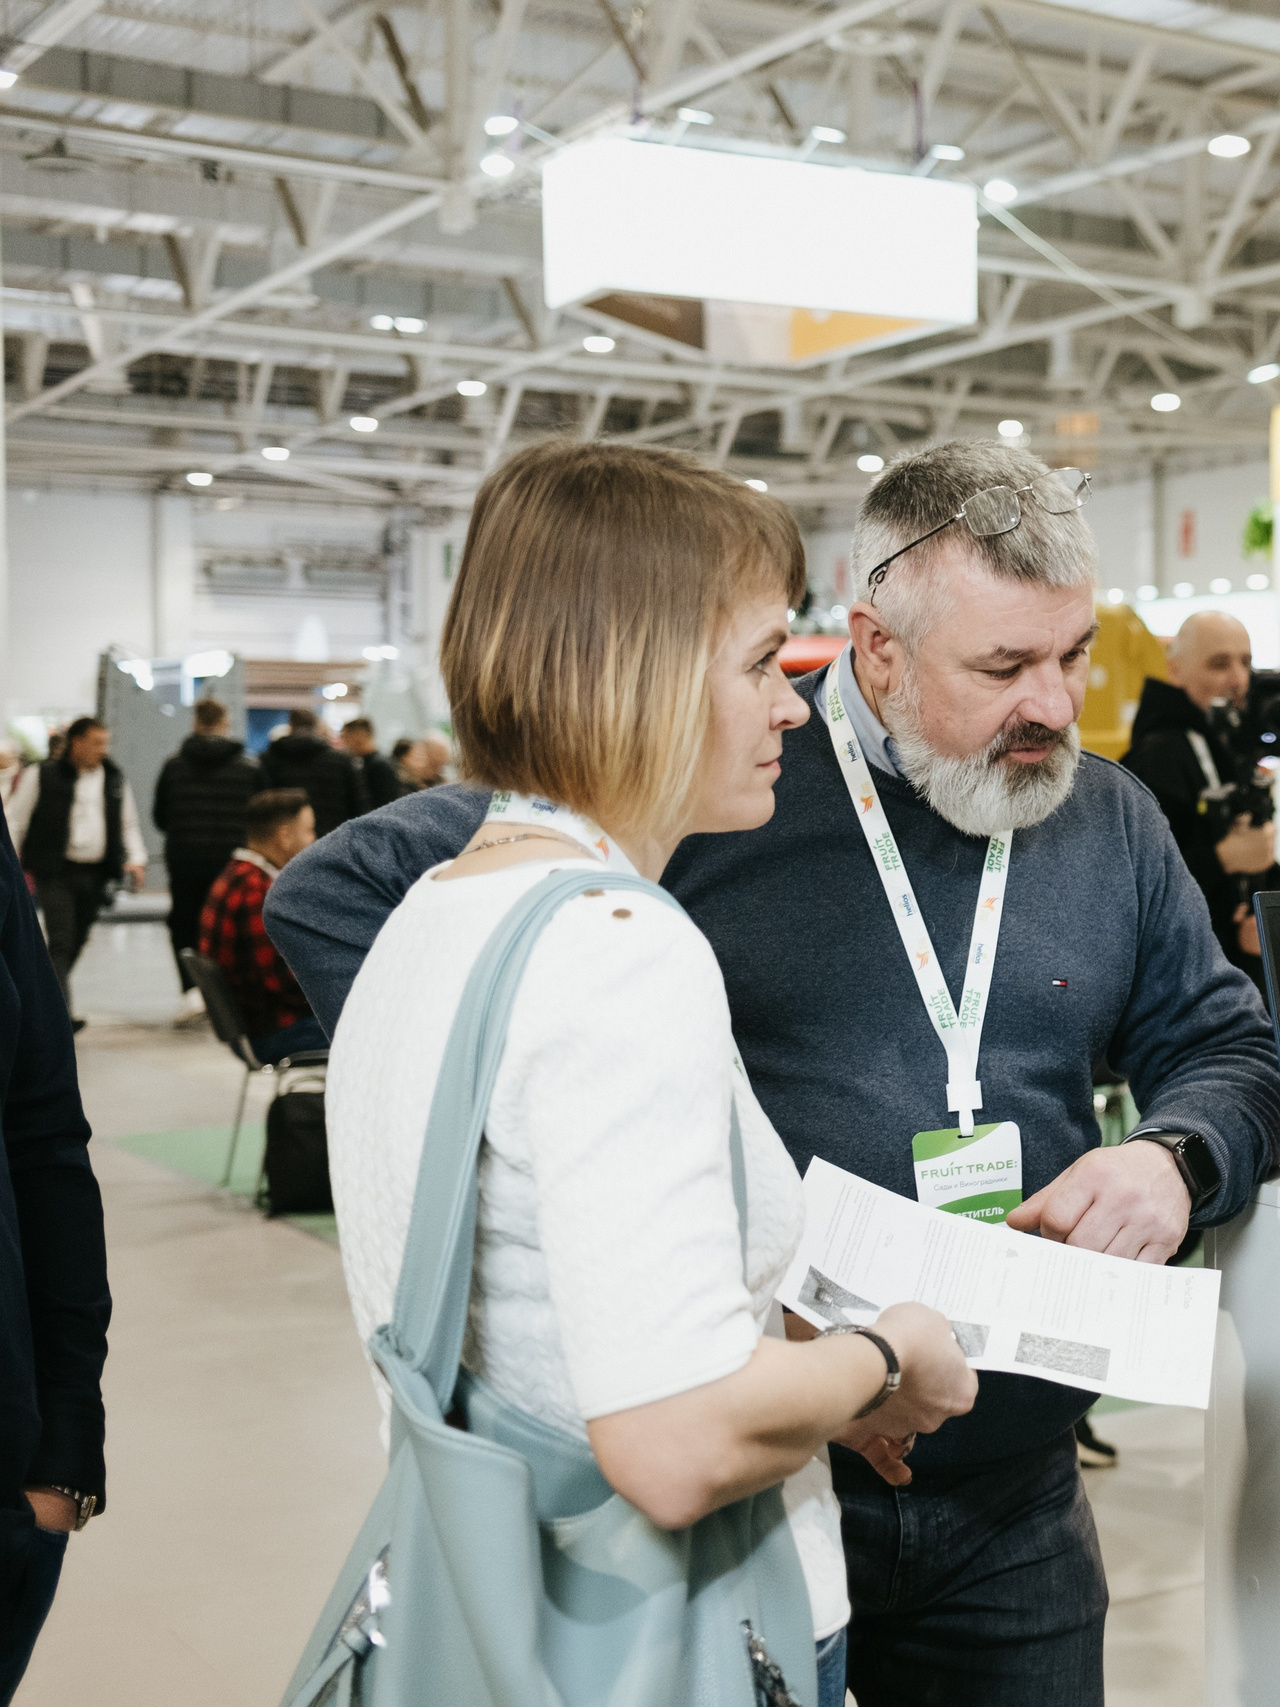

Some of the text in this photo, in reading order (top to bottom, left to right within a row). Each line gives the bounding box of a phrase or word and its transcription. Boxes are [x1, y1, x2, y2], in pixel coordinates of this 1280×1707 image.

[882, 831, 901, 871] TRADE
[986, 837, 999, 872] TRADE
[902, 893, 913, 917] helios
[938, 987, 956, 1029] TRADE
[960, 988, 973, 1029] TRADE
[933, 1183, 952, 1191] Сады
[959, 1177, 1008, 1189] Виноградники
